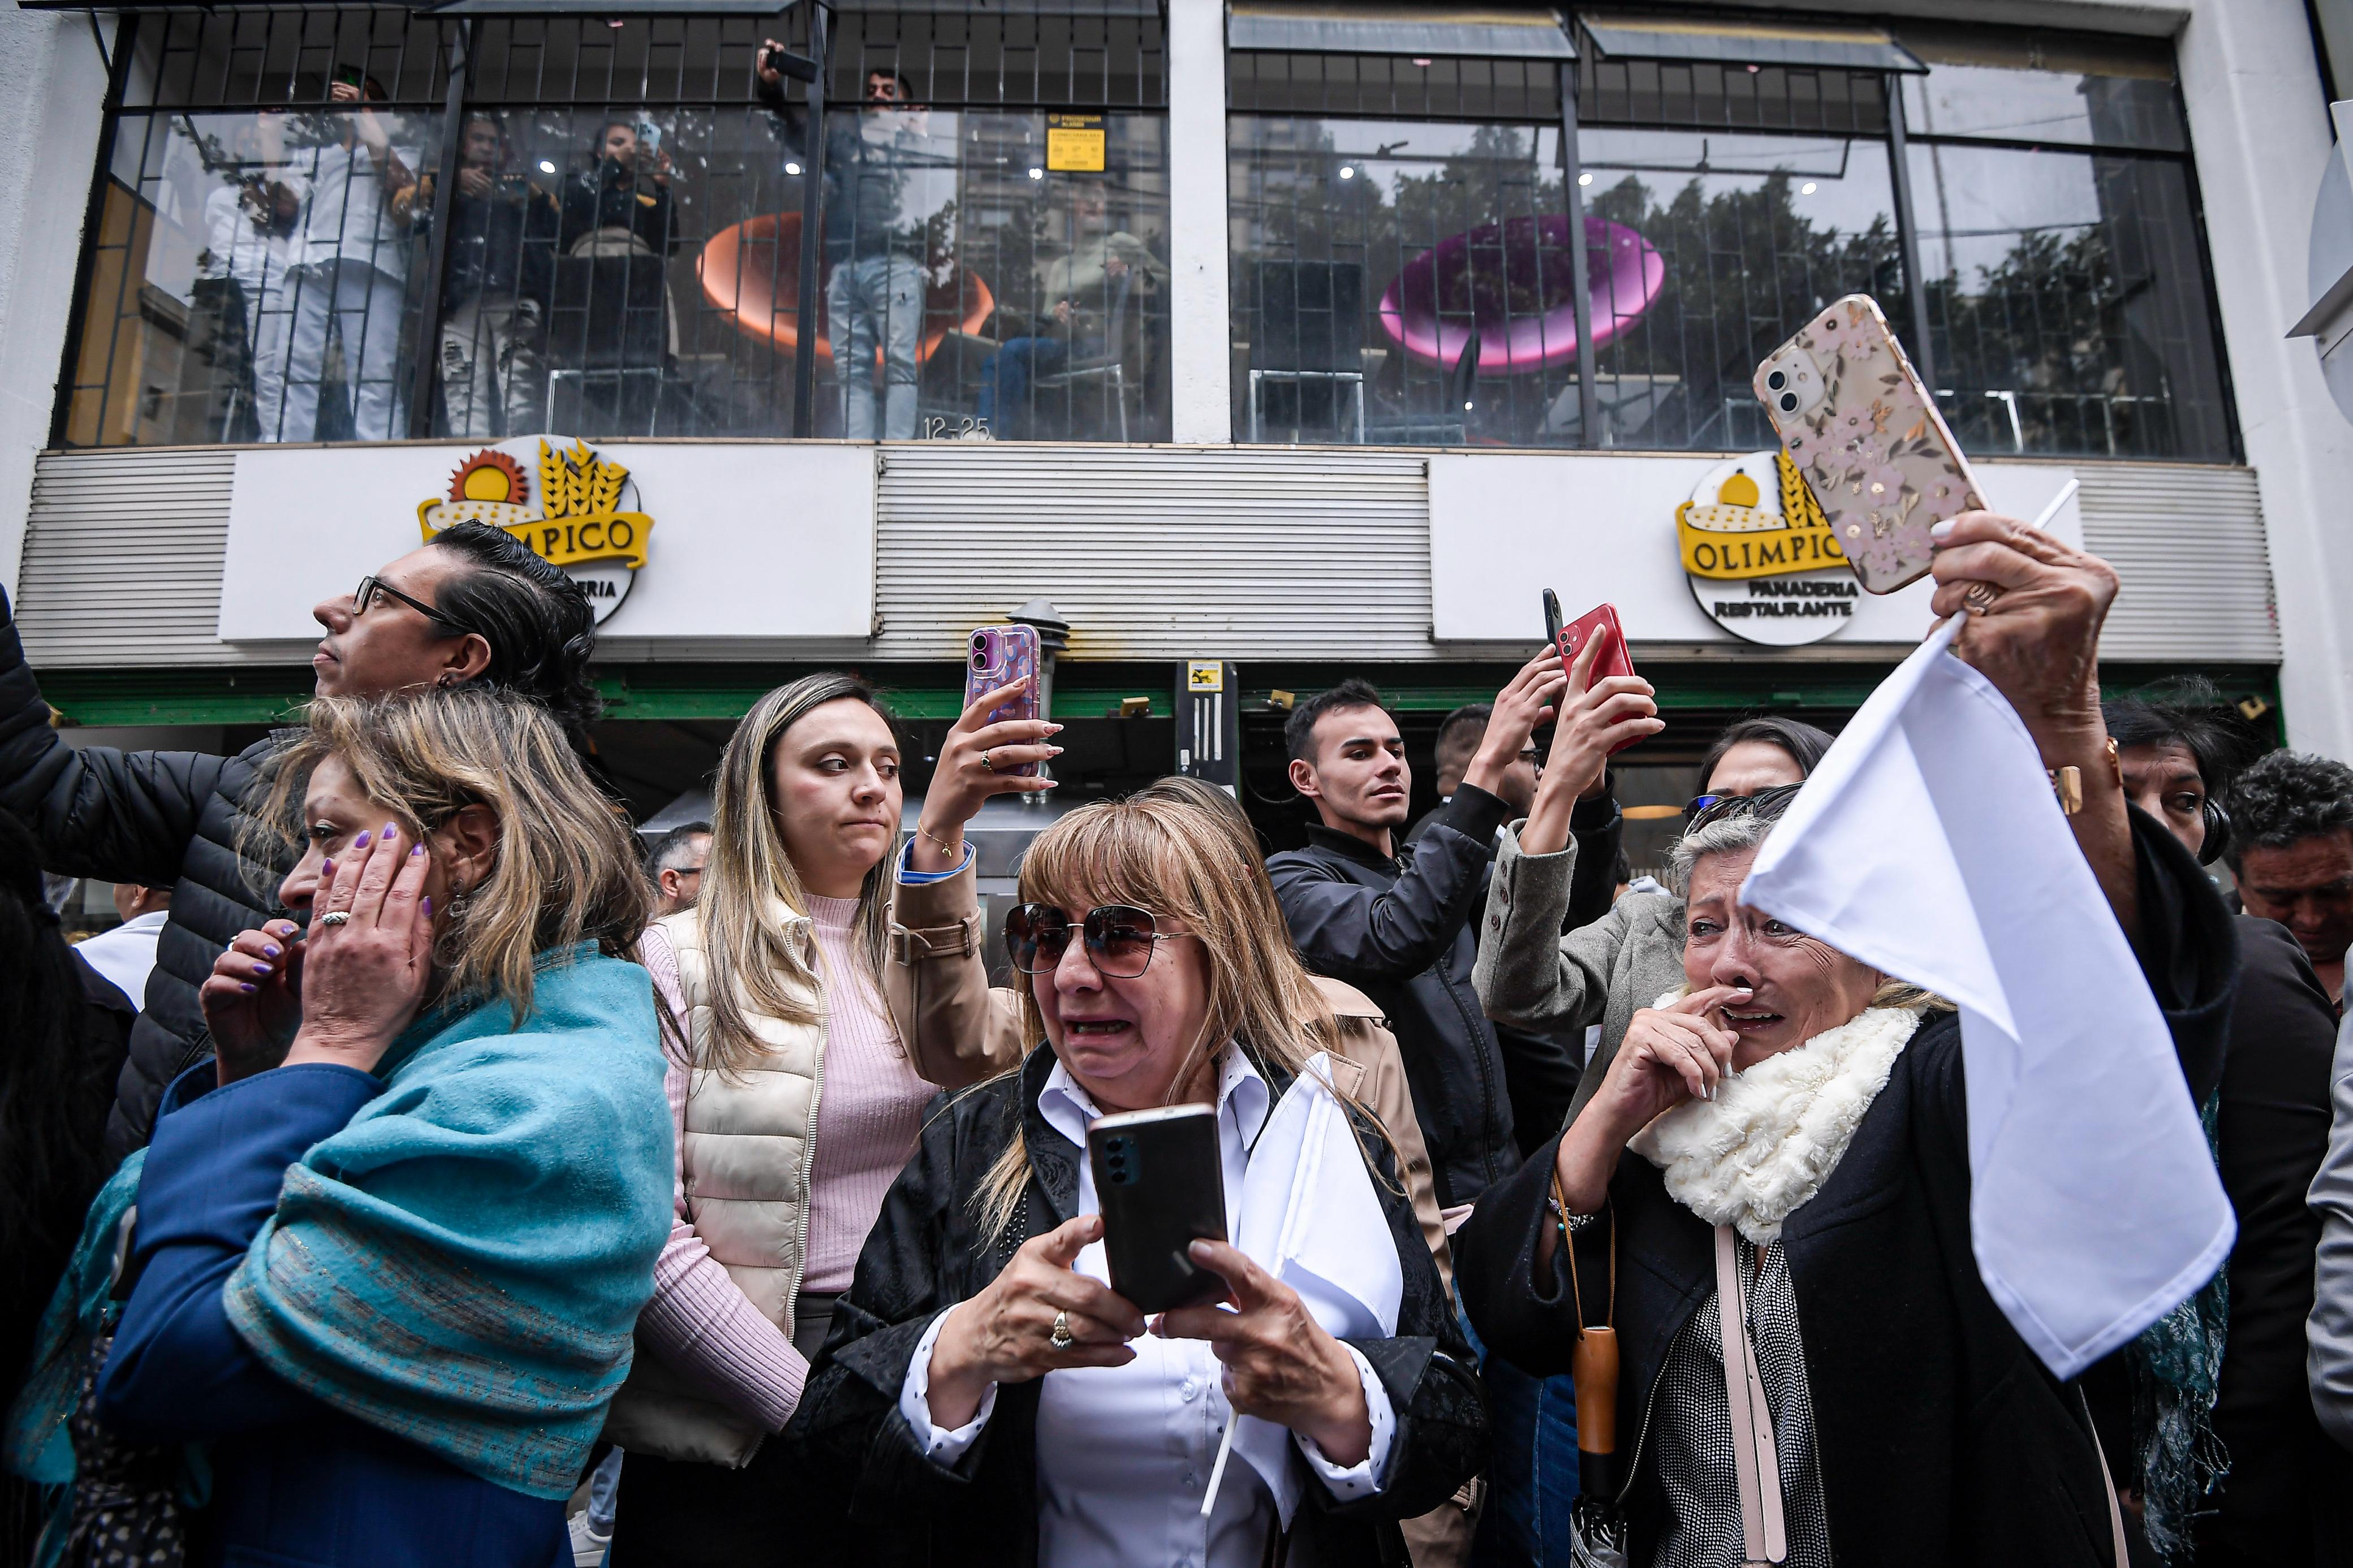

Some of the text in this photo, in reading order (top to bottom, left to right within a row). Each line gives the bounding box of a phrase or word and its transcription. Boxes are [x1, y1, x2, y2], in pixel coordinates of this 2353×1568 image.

[924, 417, 990, 440] 12-25
[1748, 581, 1859, 597] PANADERIA
[1714, 601, 1852, 617] RESTAURANTE
